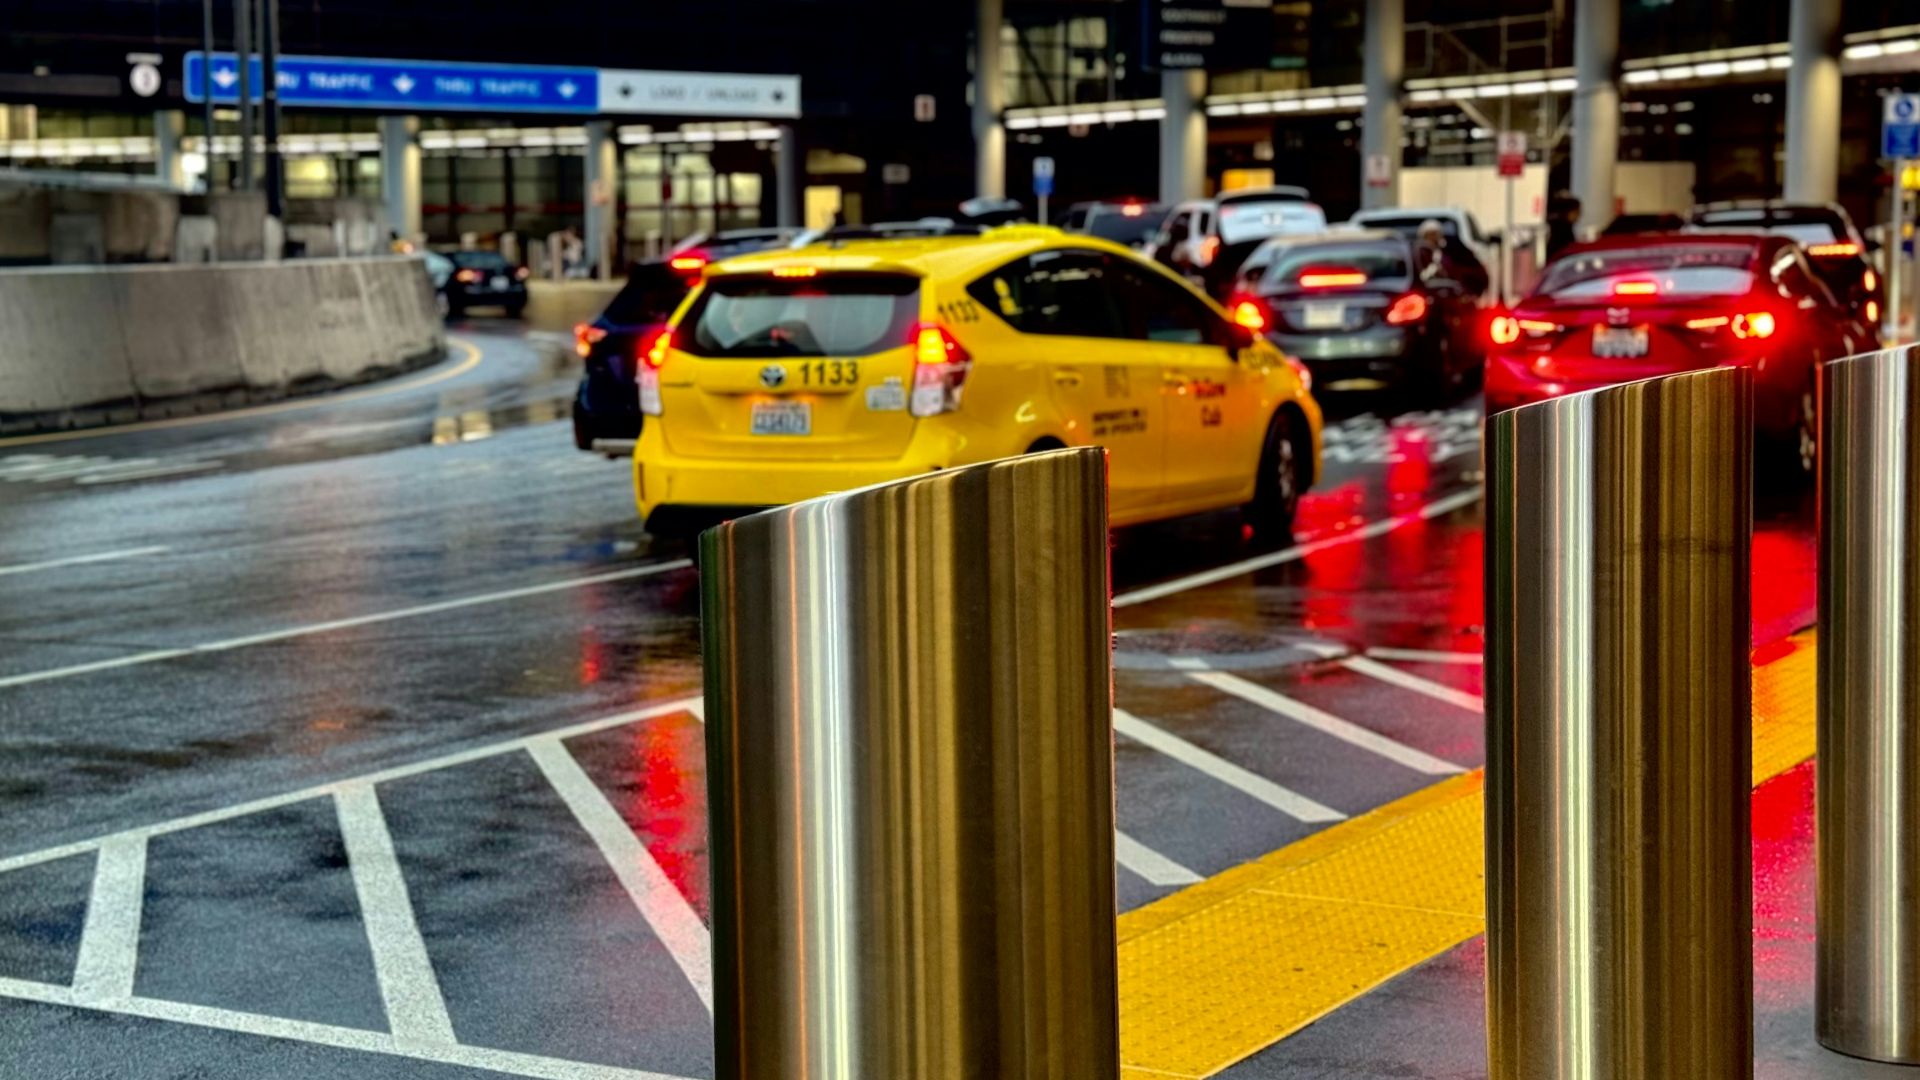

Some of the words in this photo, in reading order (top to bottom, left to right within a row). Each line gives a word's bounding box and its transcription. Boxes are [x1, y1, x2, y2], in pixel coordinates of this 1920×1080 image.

[308, 73, 371, 91] TRAFFIC
[434, 78, 473, 95] THRU
[480, 79, 541, 97] TRAFFIC
[937, 301, 979, 323] 1133
[800, 362, 859, 384] 1133
